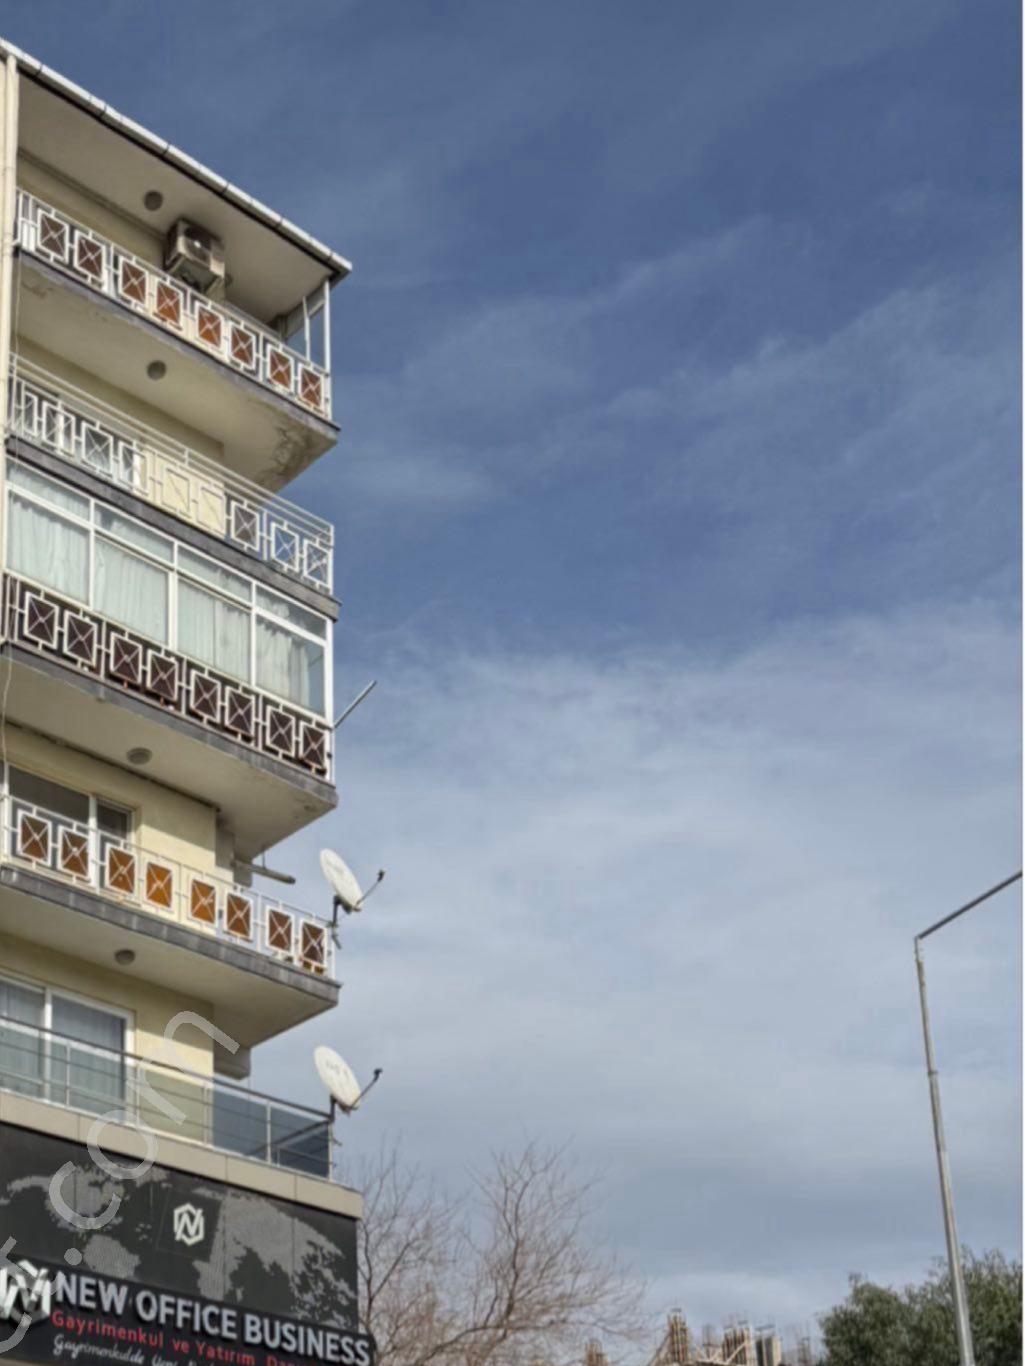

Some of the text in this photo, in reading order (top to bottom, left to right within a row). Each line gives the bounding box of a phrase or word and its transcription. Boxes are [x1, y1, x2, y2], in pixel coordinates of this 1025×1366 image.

[51, 1311, 164, 1348] Gayrimenkul
[172, 1338, 190, 1355] ve
[56, 1270, 129, 1315] NEW
[135, 1290, 238, 1341] OFFICE
